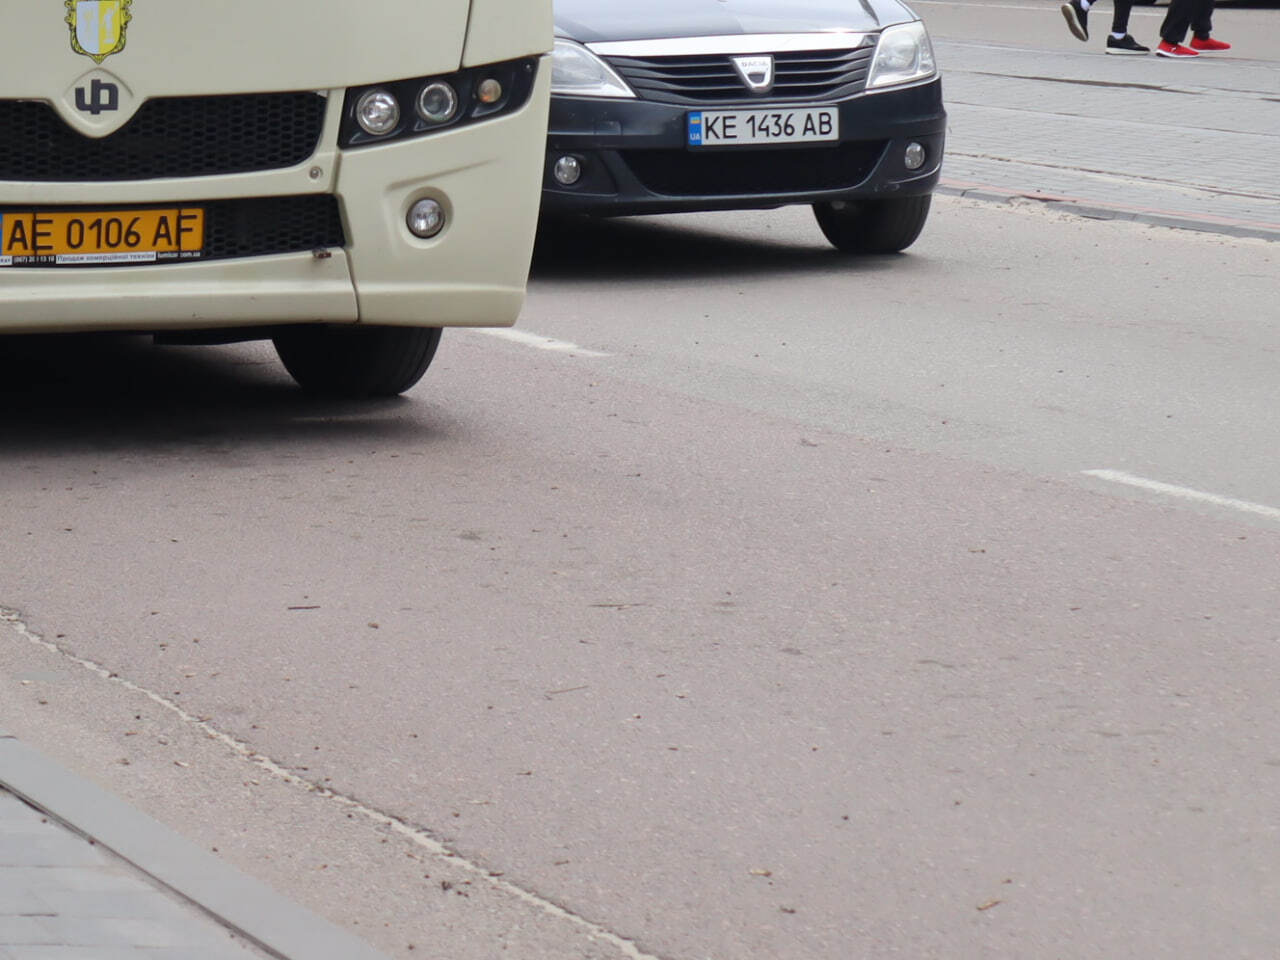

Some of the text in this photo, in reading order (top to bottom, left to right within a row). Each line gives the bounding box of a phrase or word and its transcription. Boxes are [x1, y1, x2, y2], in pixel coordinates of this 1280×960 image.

[704, 112, 833, 141] KE 1436 AB
[7, 218, 53, 251] AE
[66, 216, 142, 250] 0106
